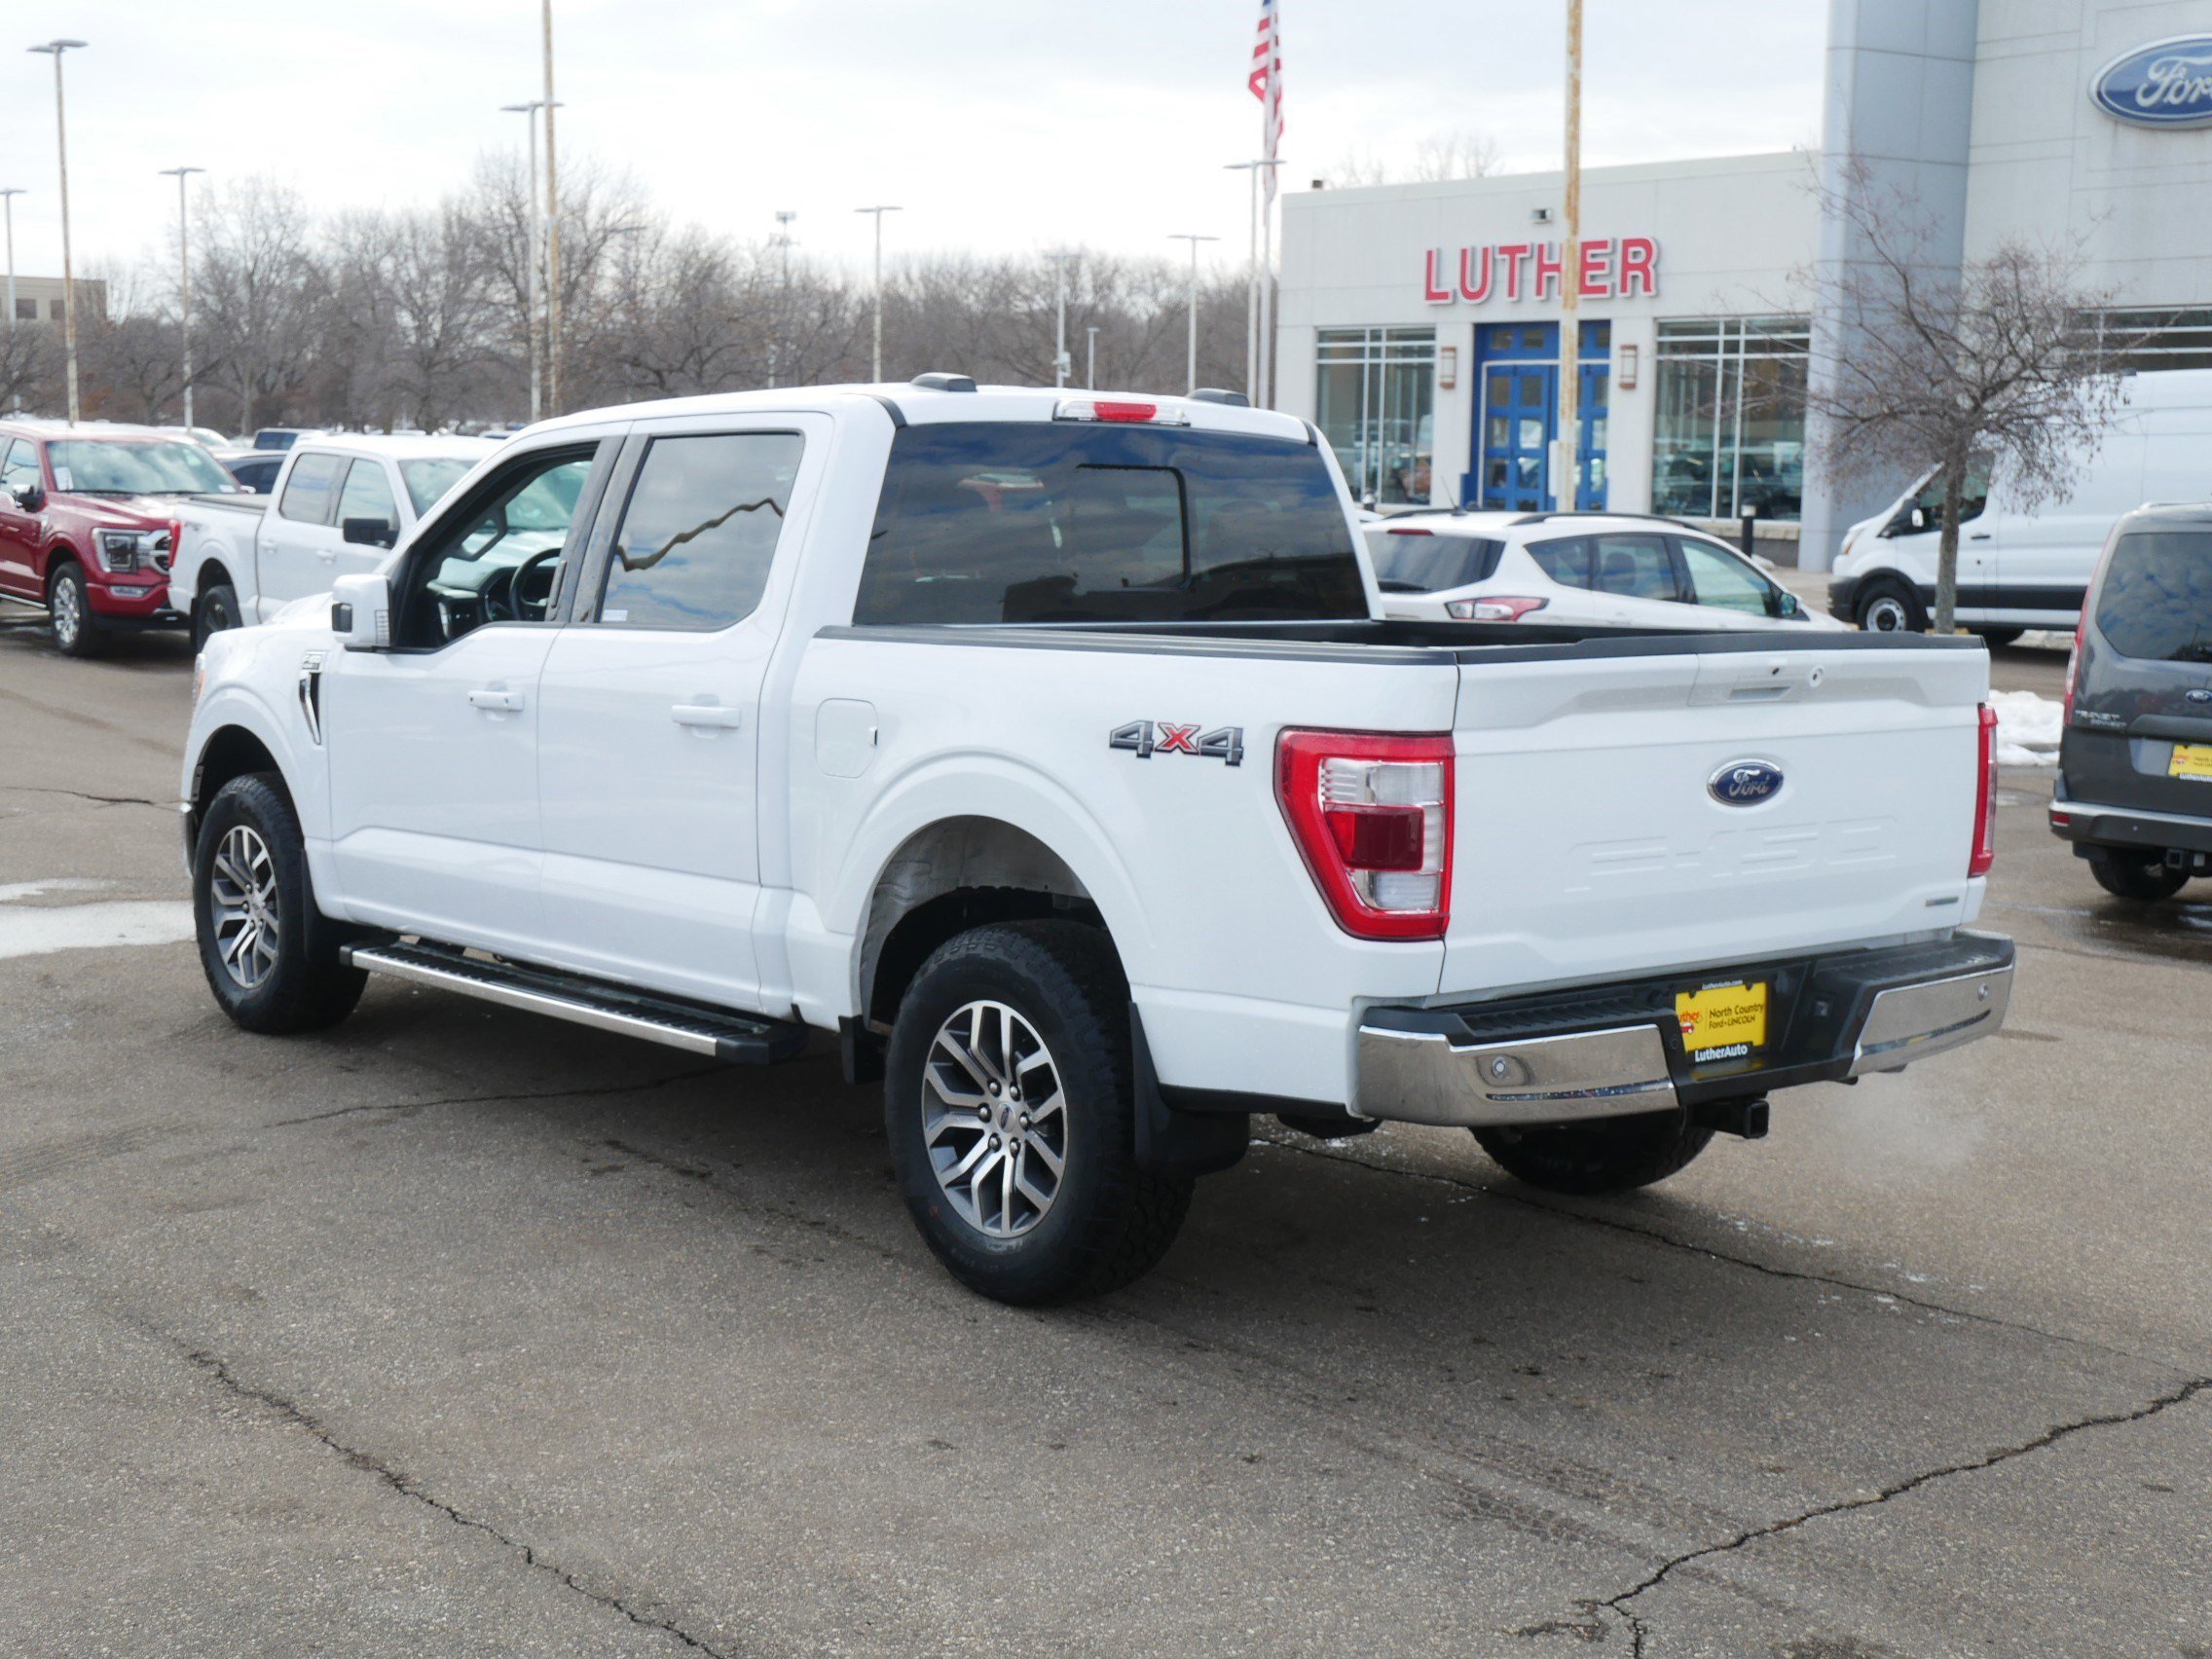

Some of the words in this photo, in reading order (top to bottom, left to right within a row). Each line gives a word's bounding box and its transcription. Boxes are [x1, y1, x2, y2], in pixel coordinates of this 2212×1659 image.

[2134, 55, 2212, 107] For
[1424, 237, 1658, 305] LUTHER
[1728, 768, 1772, 796] Ford
[1709, 1007, 1732, 1018] North
[1734, 1004, 1764, 1014] Country
[1695, 1044, 1749, 1062] LutherAuto
